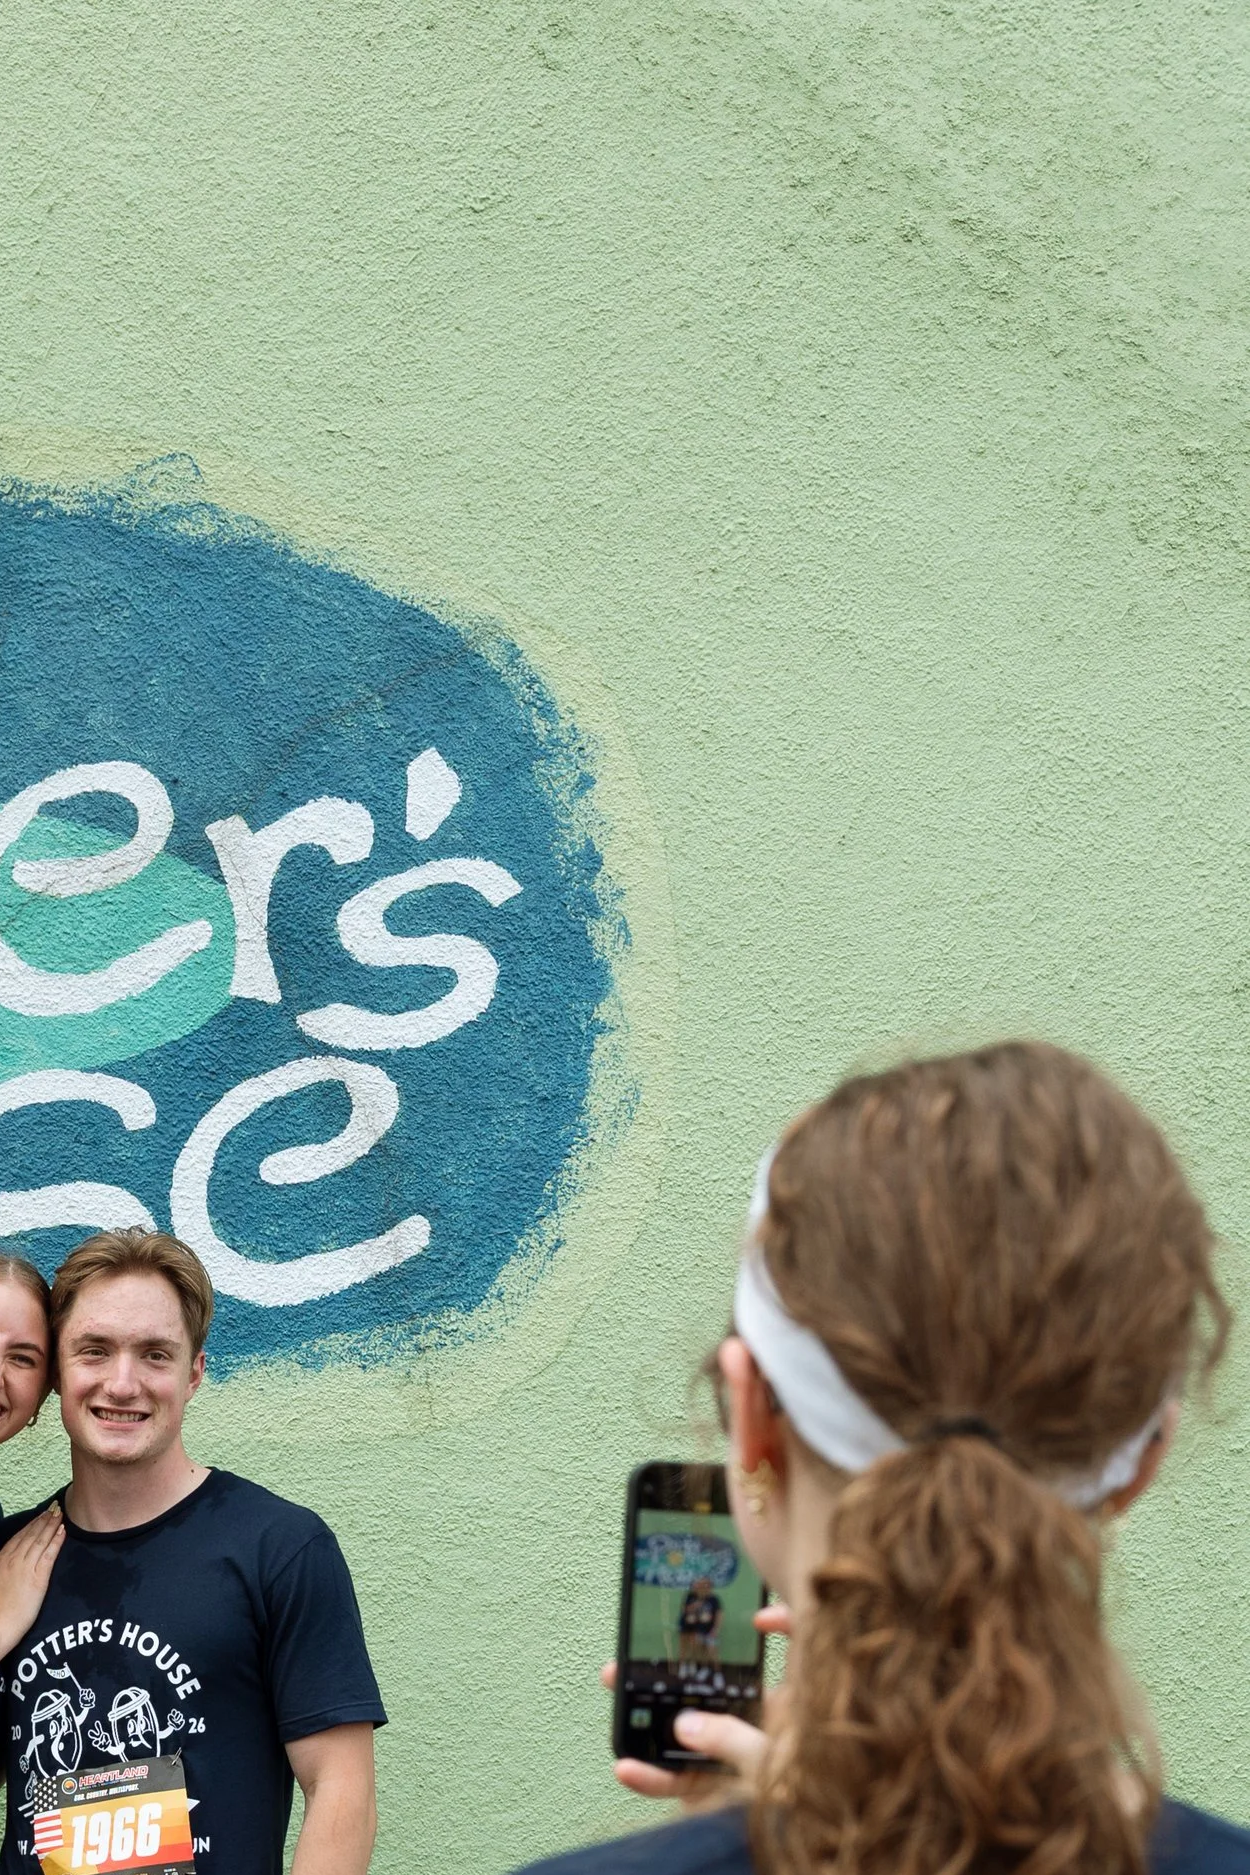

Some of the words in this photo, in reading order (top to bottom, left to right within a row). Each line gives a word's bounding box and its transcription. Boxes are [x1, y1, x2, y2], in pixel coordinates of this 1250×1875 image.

[11, 1618, 113, 1701] POTTER'S
[119, 1622, 201, 1700] HOUSE
[188, 1717, 206, 1734] 26
[79, 1765, 148, 1787] HEARTLAND
[70, 1802, 162, 1869] 1966
